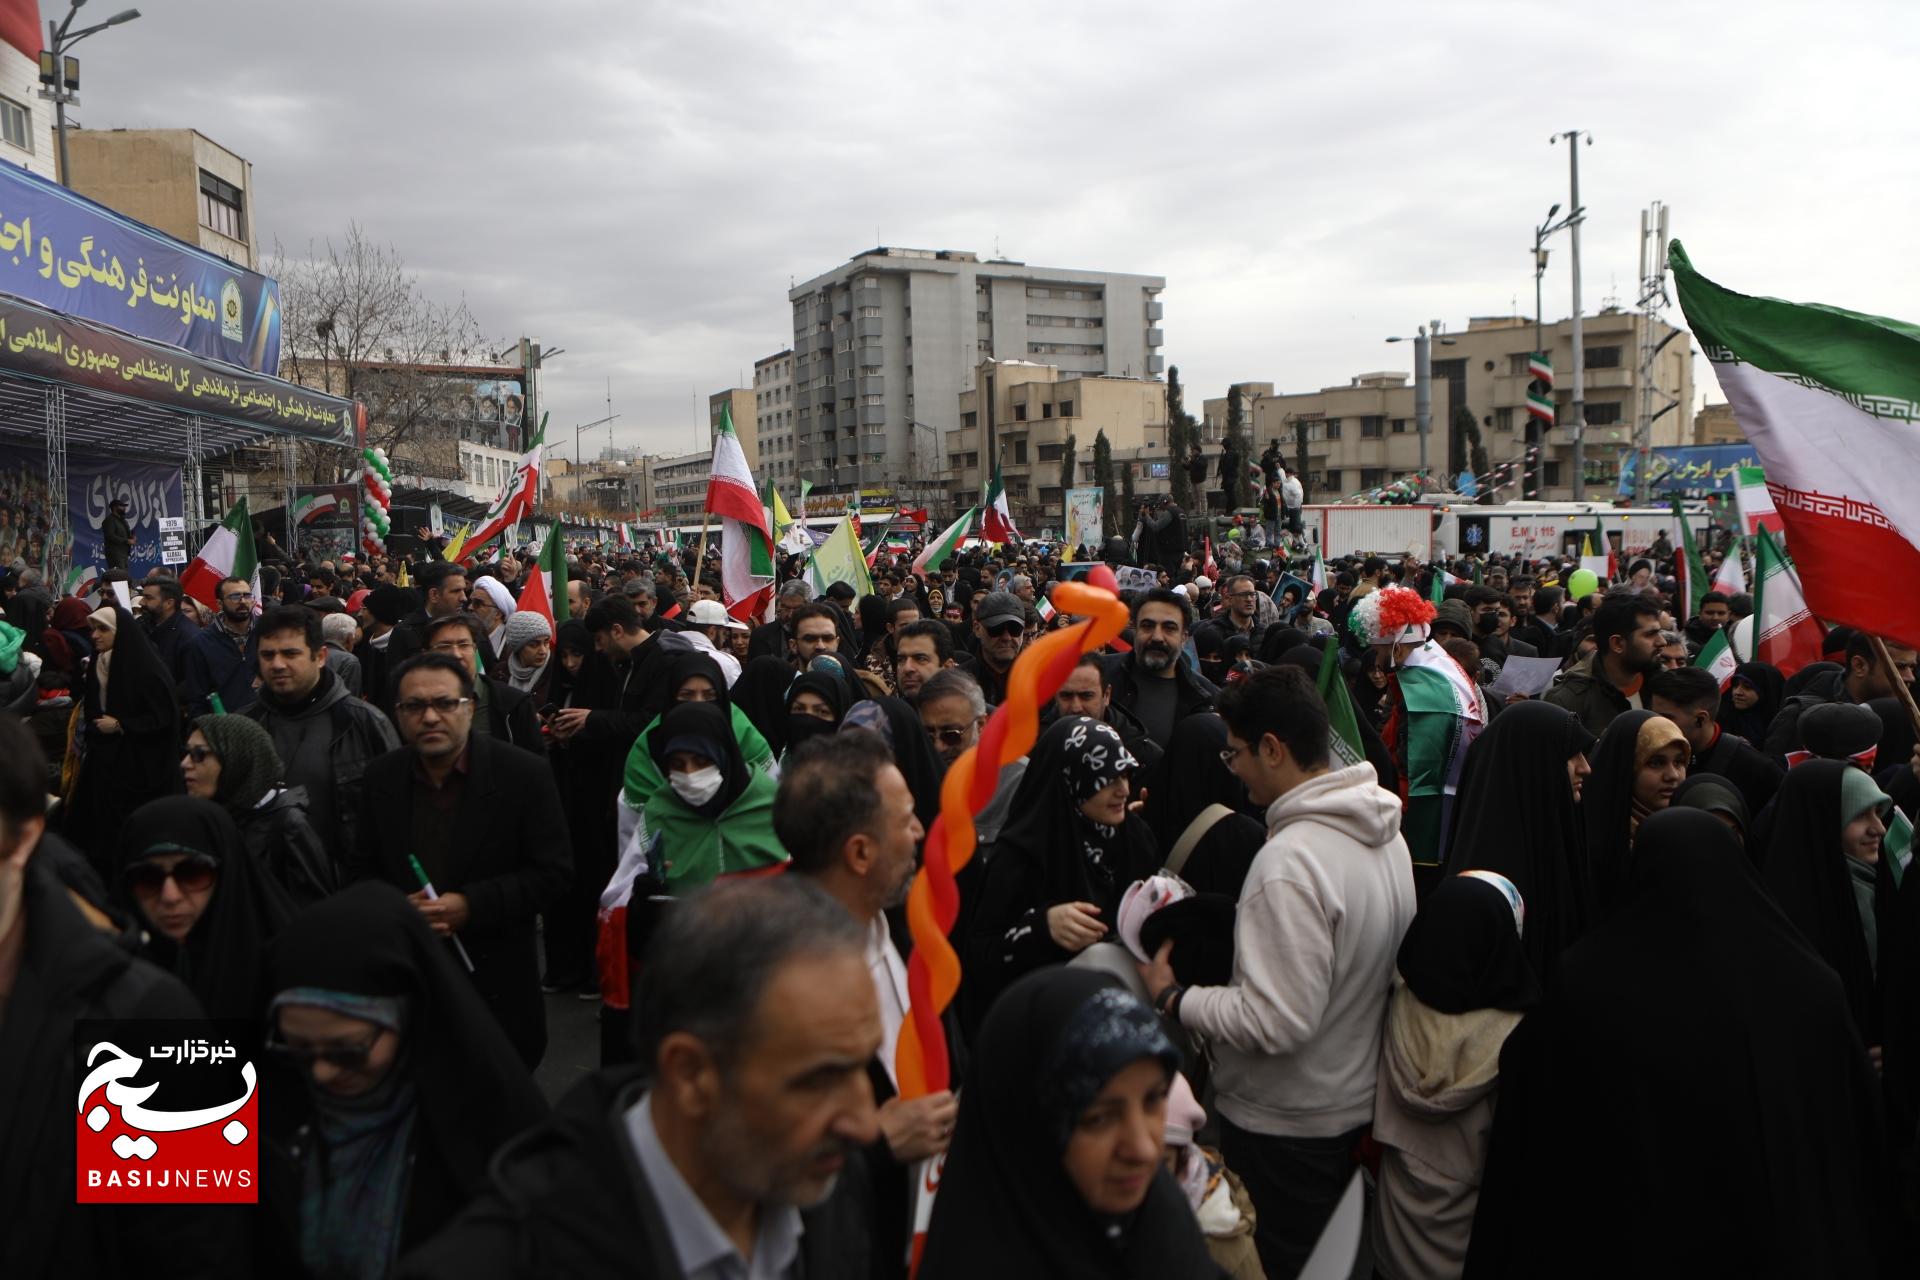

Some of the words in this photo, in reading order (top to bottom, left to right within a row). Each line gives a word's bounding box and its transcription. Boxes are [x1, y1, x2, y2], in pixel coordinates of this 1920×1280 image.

[38, 236, 54, 279] و
[57, 235, 148, 308] فرهنگی
[150, 274, 216, 325] معاونت
[9, 327, 63, 354] اسلامی
[65, 344, 120, 374] جمهوری
[121, 358, 173, 383] انتظامی
[174, 367, 191, 392] کل
[192, 376, 239, 404] فرماندهی
[240, 388, 276, 411] اجتماعی
[283, 396, 312, 421] فرهنگی
[312, 406, 336, 426] معاونت
